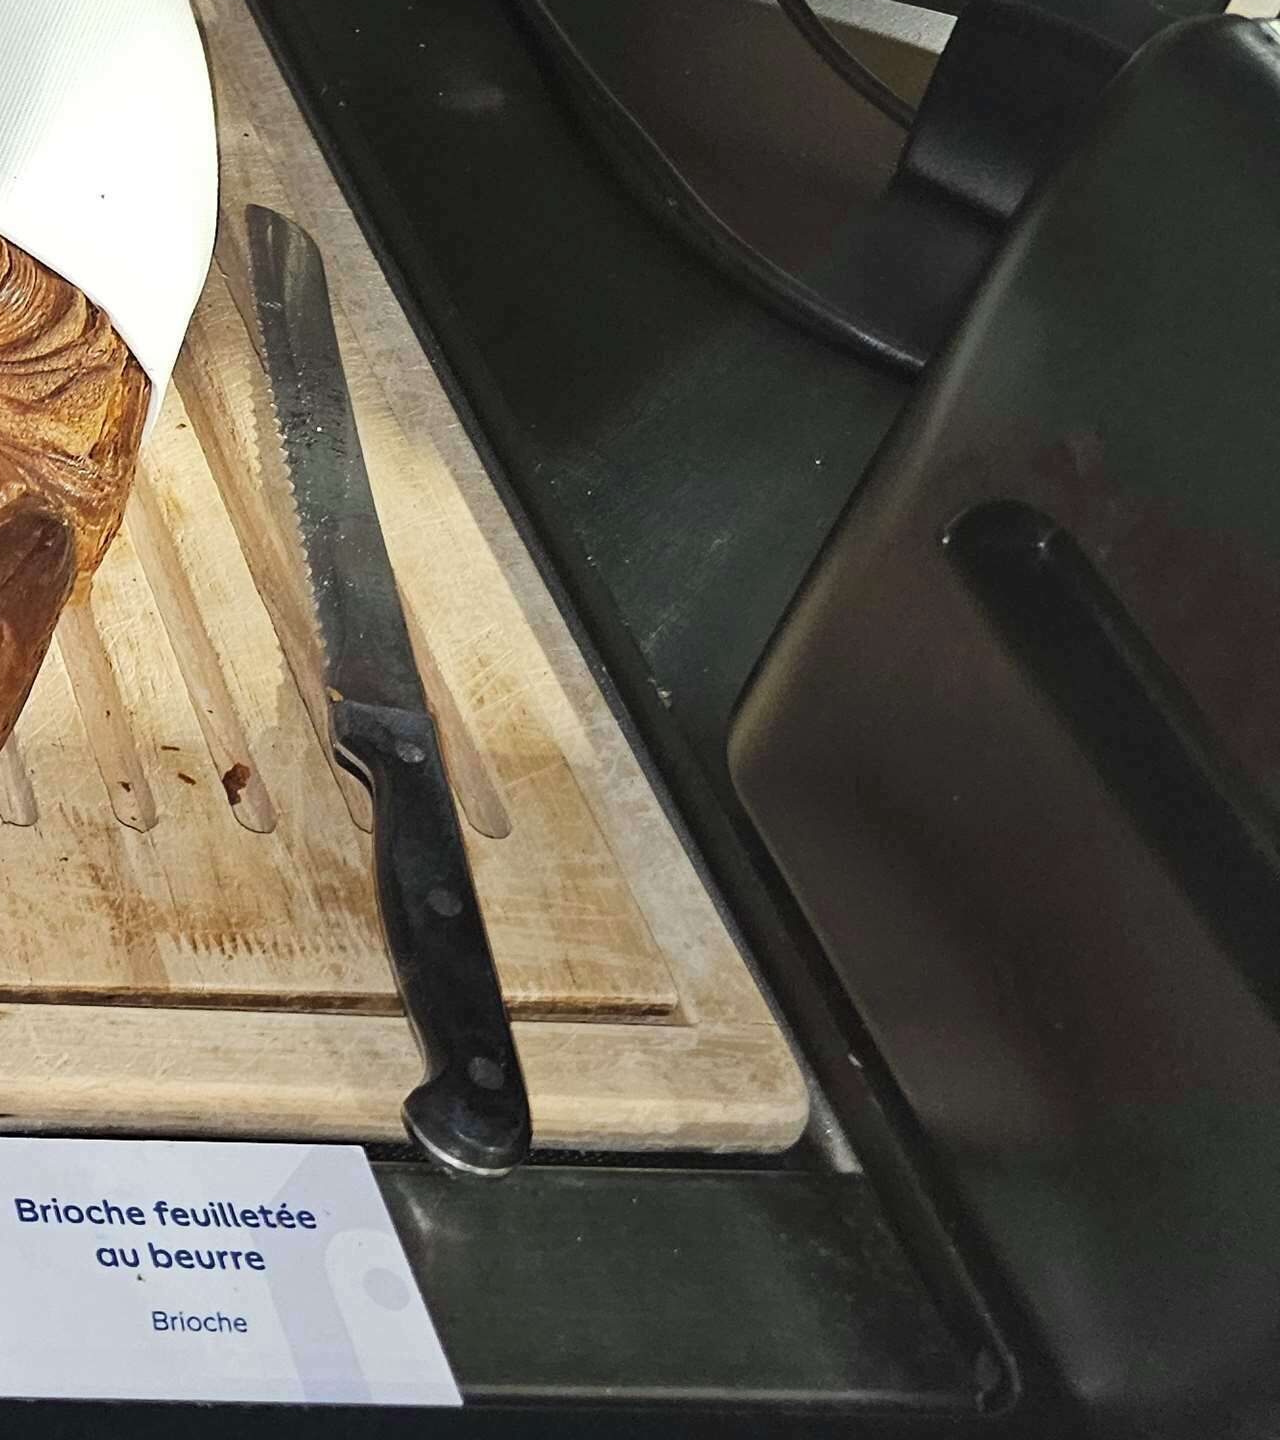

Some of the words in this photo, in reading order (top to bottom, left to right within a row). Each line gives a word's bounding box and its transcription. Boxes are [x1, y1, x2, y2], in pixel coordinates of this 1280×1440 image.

[14, 1197, 147, 1228] Brioche
[153, 1200, 318, 1230] feuilletée
[95, 1244, 140, 1269] au
[148, 1242, 267, 1271] beurre
[151, 1310, 249, 1334] Brioche
